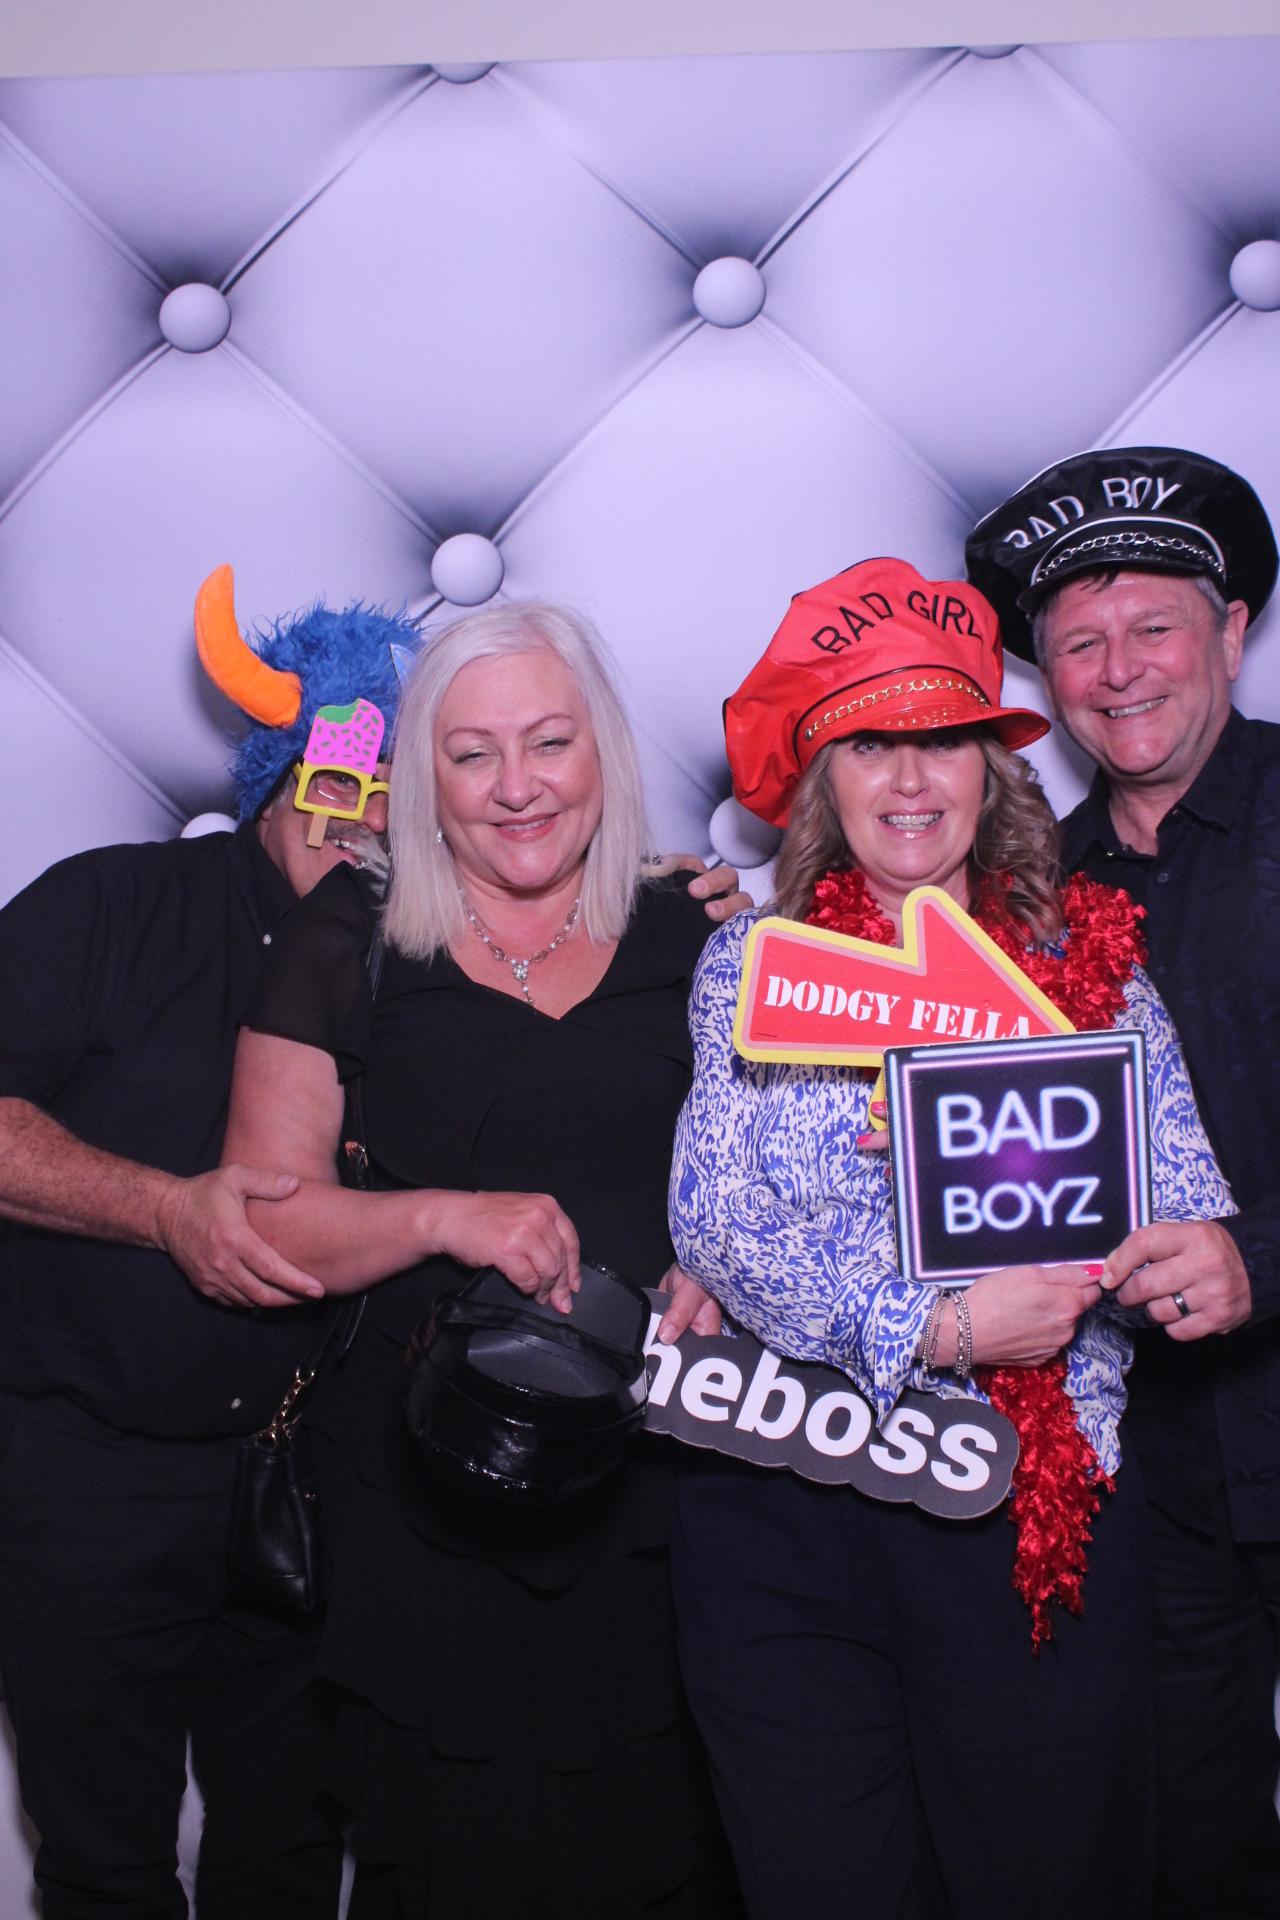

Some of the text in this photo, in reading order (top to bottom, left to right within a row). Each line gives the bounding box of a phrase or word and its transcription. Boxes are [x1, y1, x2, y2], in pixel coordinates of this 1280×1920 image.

[1102, 476, 1182, 510] BOY
[811, 590, 983, 655] BAD GIRL
[764, 975, 1030, 1041] DODGY FELLA
[936, 1085, 1102, 1159] BAD
[943, 1176, 1103, 1235] BOYZ
